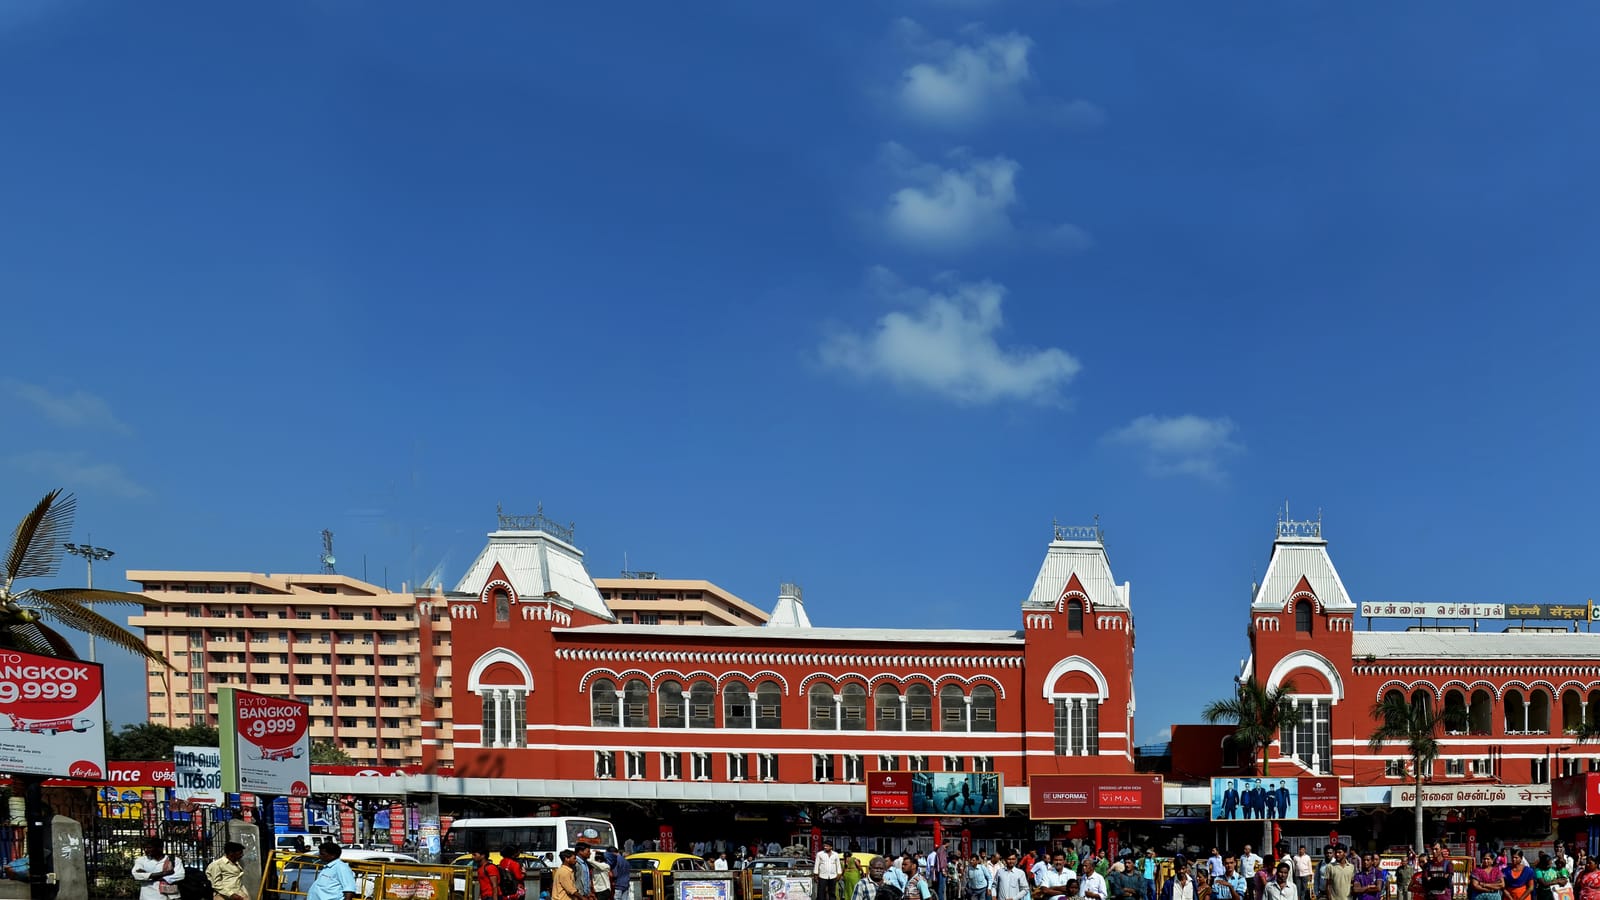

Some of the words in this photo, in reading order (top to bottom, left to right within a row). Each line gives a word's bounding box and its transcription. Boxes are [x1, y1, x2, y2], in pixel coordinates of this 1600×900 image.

[0, 653, 22, 664] TO
[239, 698, 254, 706] FLY
[255, 698, 267, 706] TO
[240, 706, 302, 719] BANGKOK
